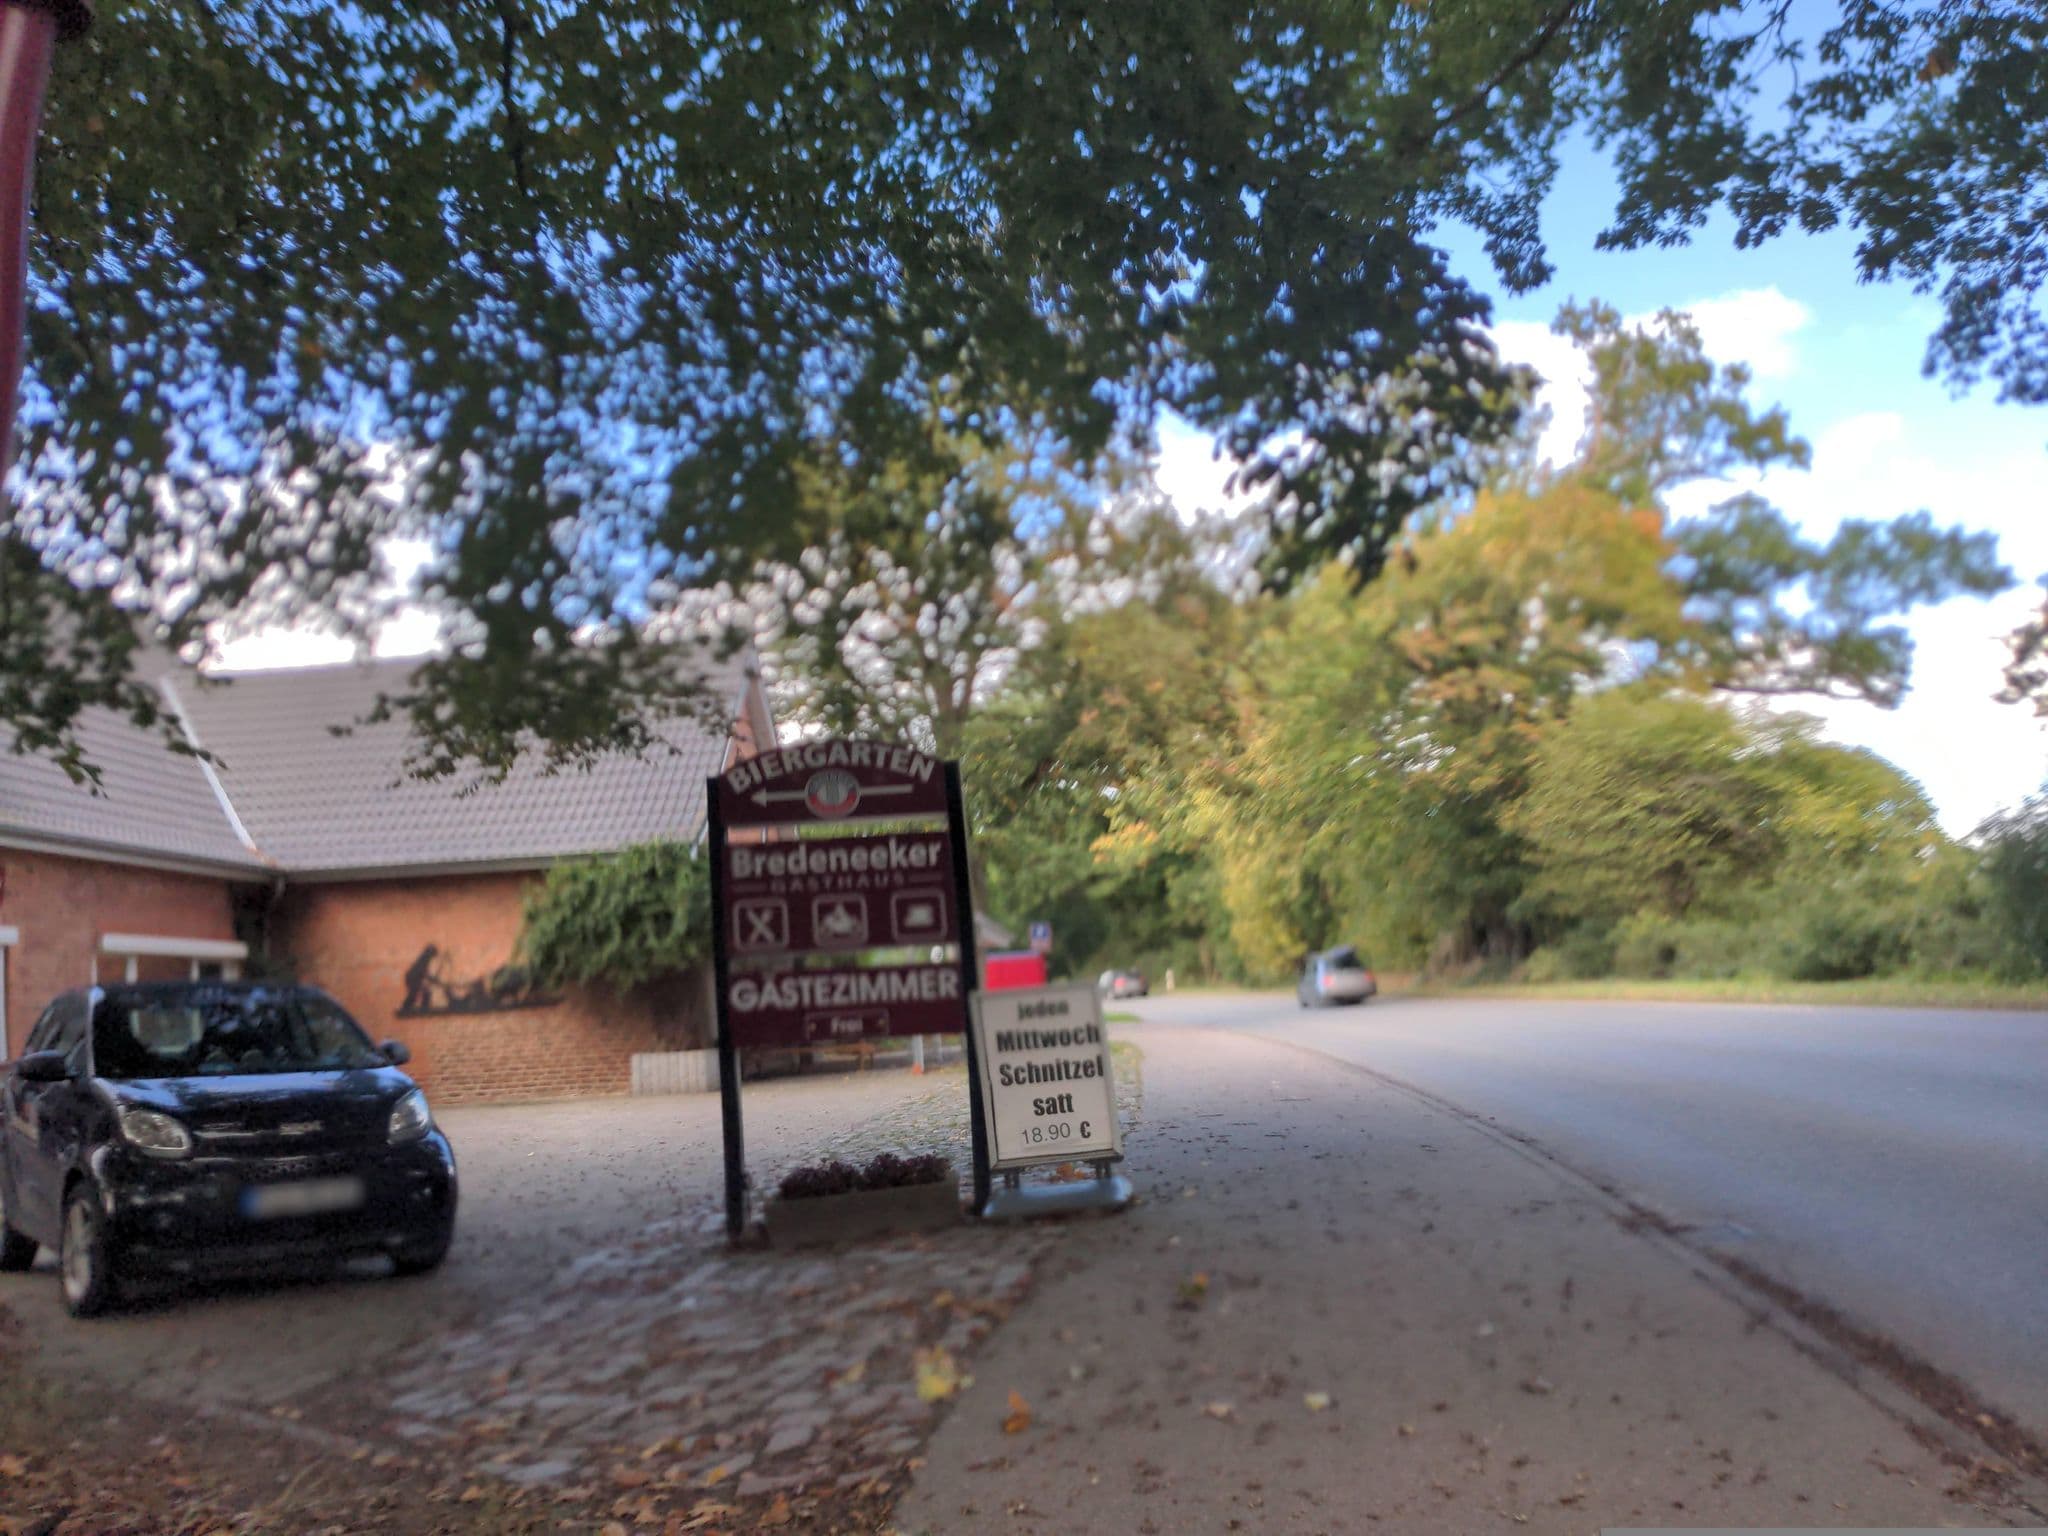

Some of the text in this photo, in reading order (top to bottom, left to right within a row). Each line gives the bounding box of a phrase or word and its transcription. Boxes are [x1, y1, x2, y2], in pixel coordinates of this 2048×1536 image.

[727, 741, 935, 794] BIERGARTEN
[1018, 1000, 1069, 1020] jeden
[996, 1023, 1100, 1051] Mittwoch
[1000, 1055, 1104, 1086] Schnitzel
[1033, 1092, 1075, 1116] satt
[1021, 1122, 1071, 1144] 18.90
